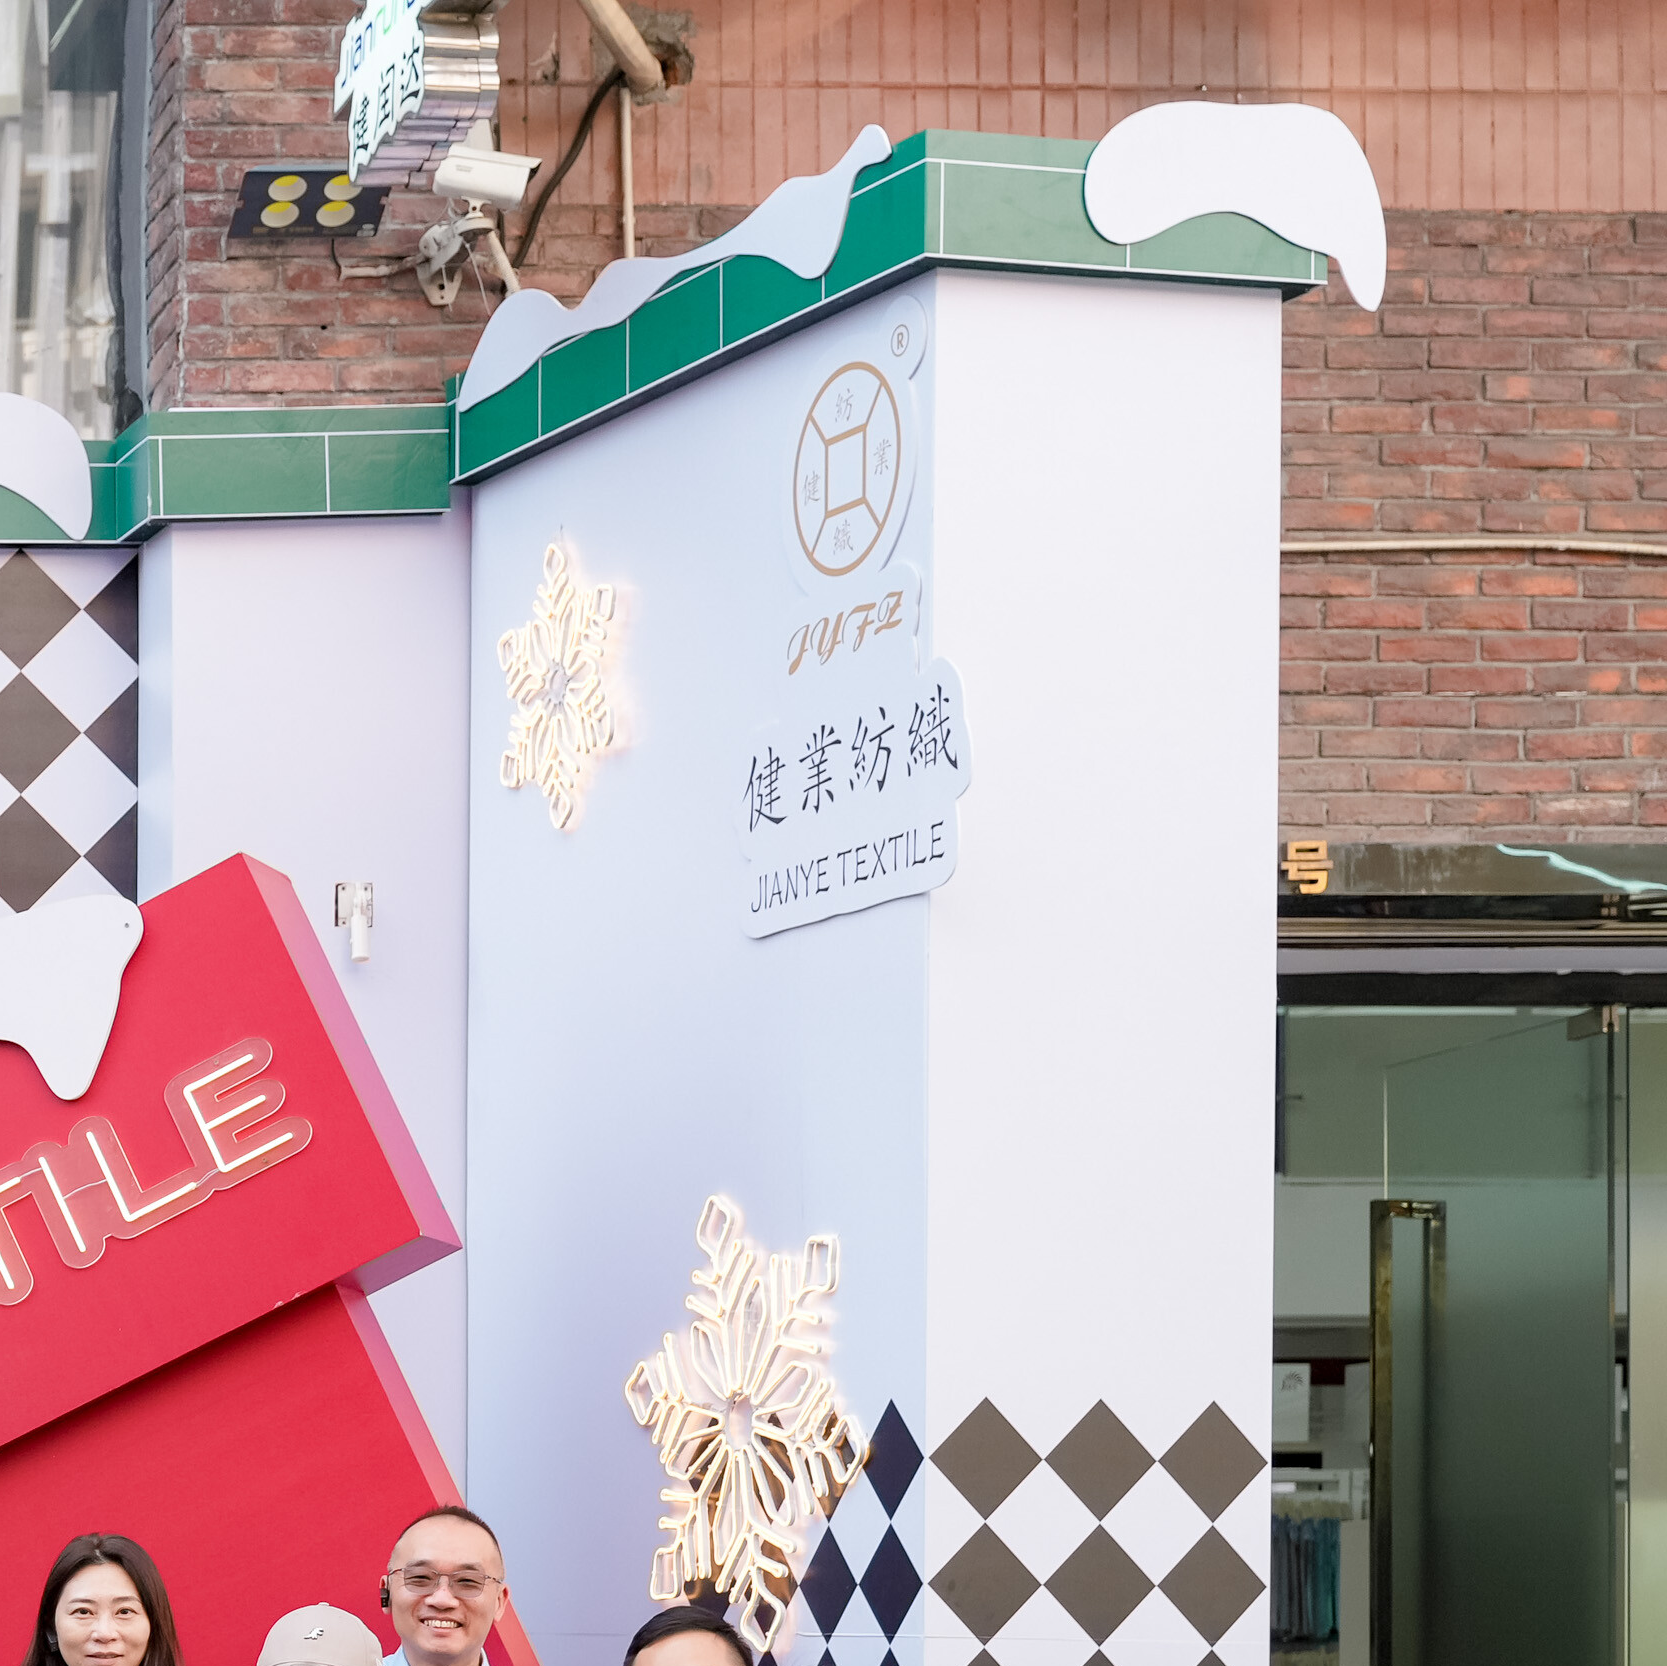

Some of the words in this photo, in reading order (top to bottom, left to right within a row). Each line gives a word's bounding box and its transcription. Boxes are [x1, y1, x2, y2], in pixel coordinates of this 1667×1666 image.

[742, 683, 959, 833] 健業紡織
[750, 855, 831, 913] JIANYE
[836, 820, 946, 887] TEXTILE
[1279, 839, 1335, 895] 号
